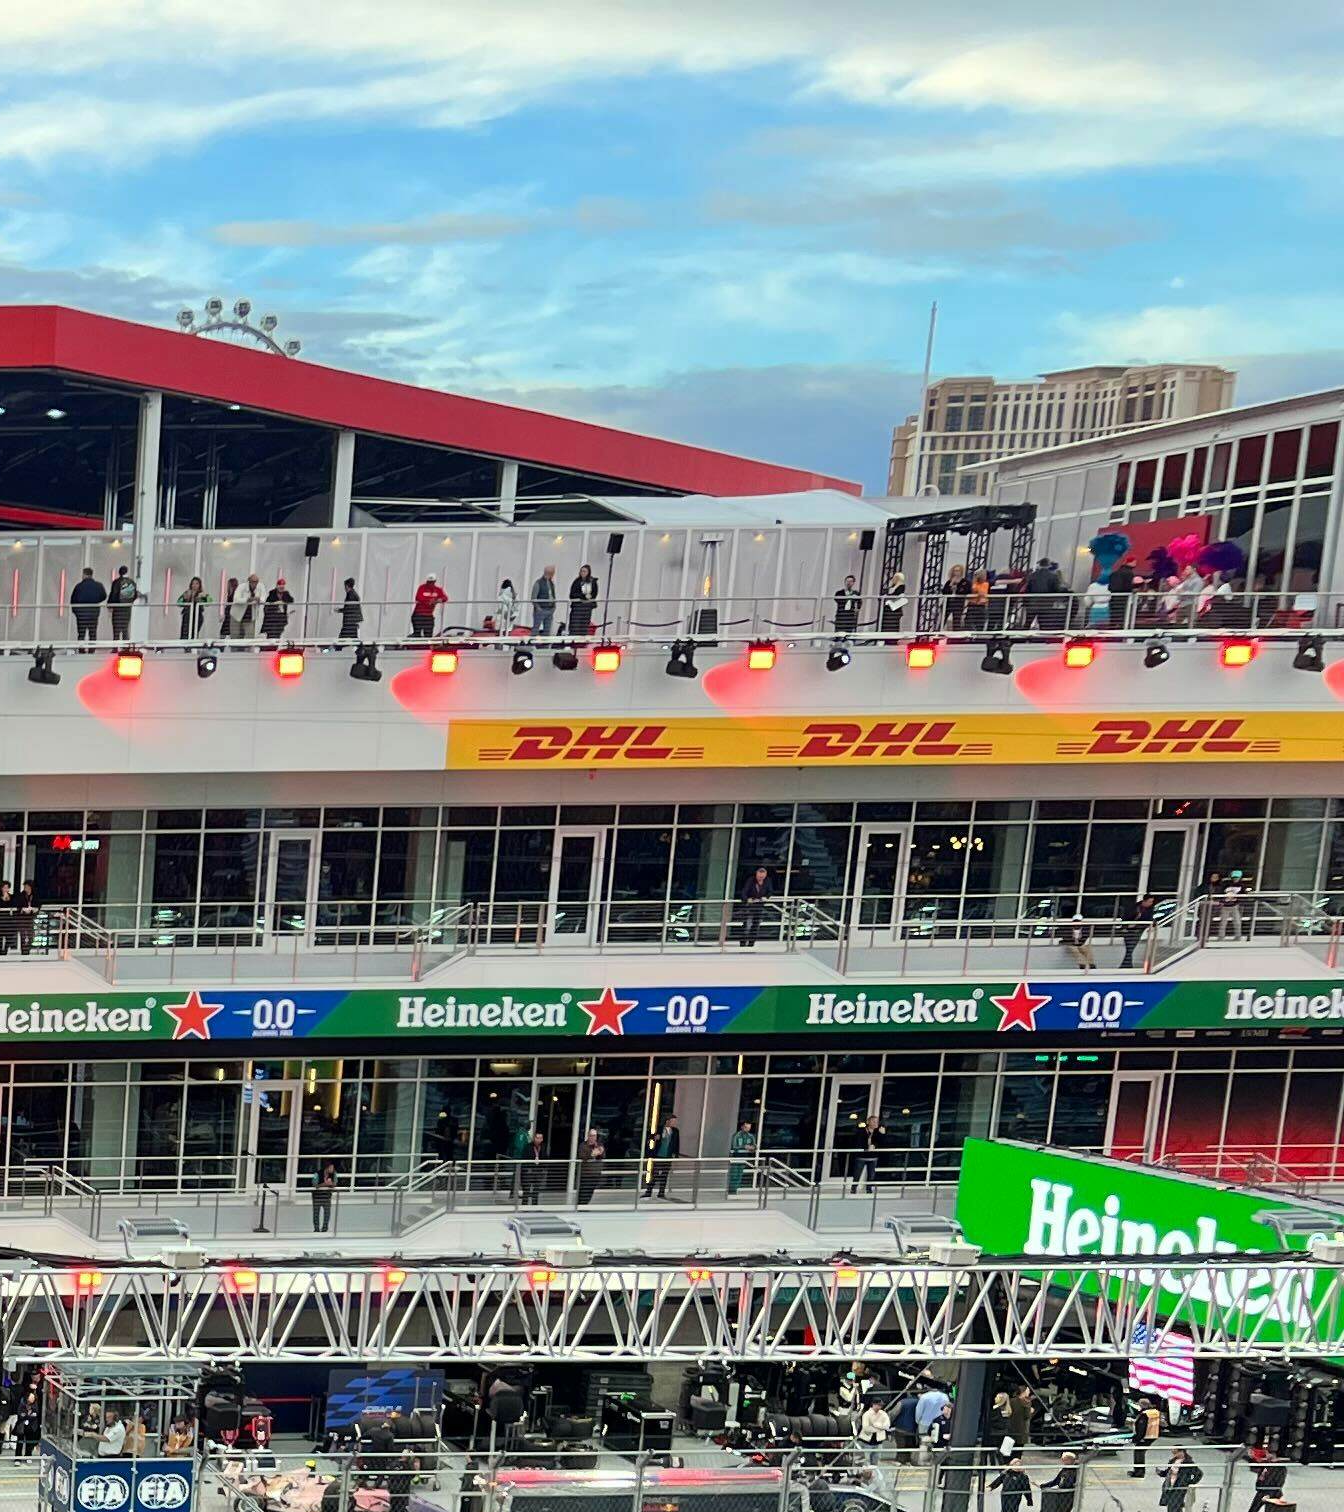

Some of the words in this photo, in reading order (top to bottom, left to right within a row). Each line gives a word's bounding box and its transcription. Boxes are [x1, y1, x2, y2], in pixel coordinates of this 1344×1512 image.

[509, 726, 676, 760] DHL
[798, 723, 966, 757] DHL
[1087, 720, 1255, 754] DHL
[253, 999, 295, 1030] 0.0
[396, 996, 568, 1028] Heineken
[667, 995, 709, 1026] 0.0
[806, 992, 979, 1024] Heineken
[1080, 990, 1123, 1021] 0.0
